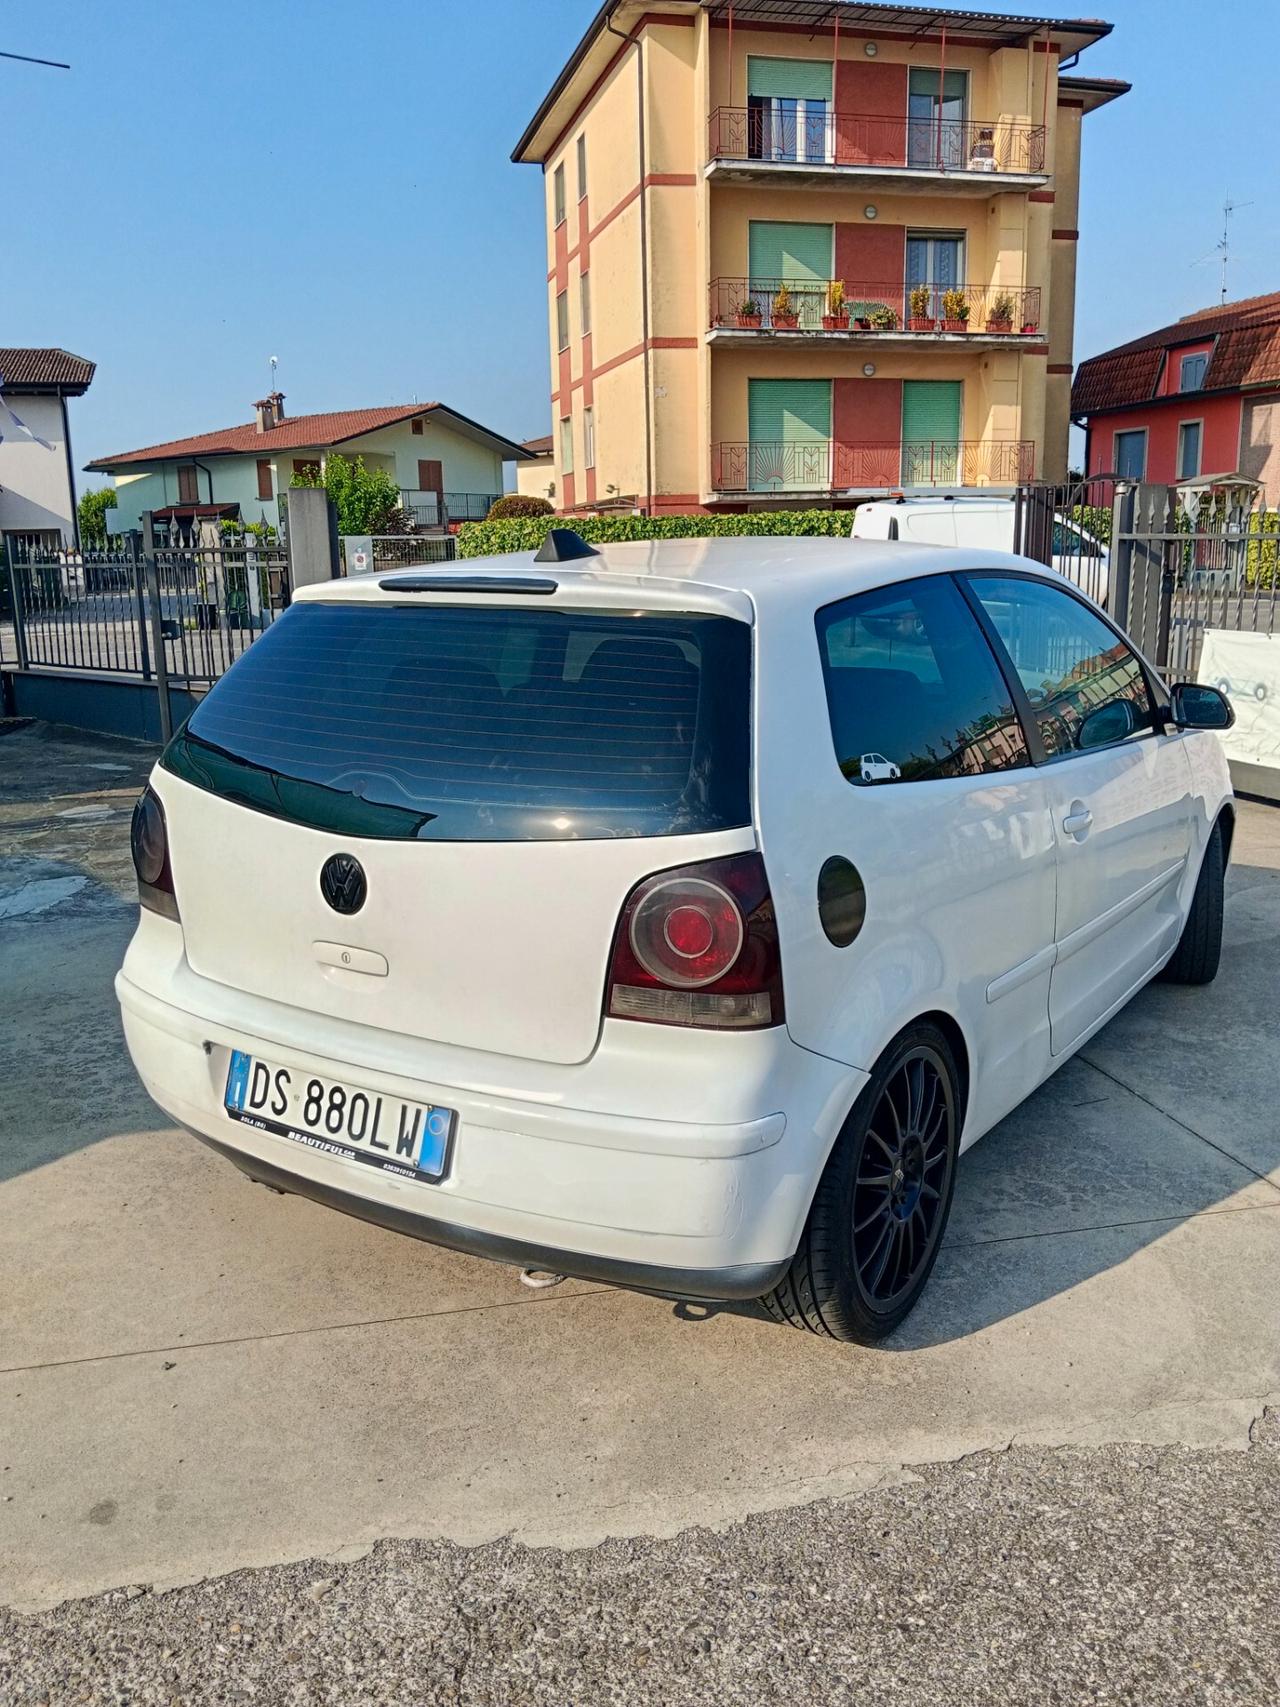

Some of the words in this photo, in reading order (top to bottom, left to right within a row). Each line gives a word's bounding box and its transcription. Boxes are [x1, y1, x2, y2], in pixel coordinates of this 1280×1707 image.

[249, 1061, 291, 1116] DS
[303, 1079, 422, 1158] 880LW
[287, 1131, 344, 1155] BEAUTIFUL
